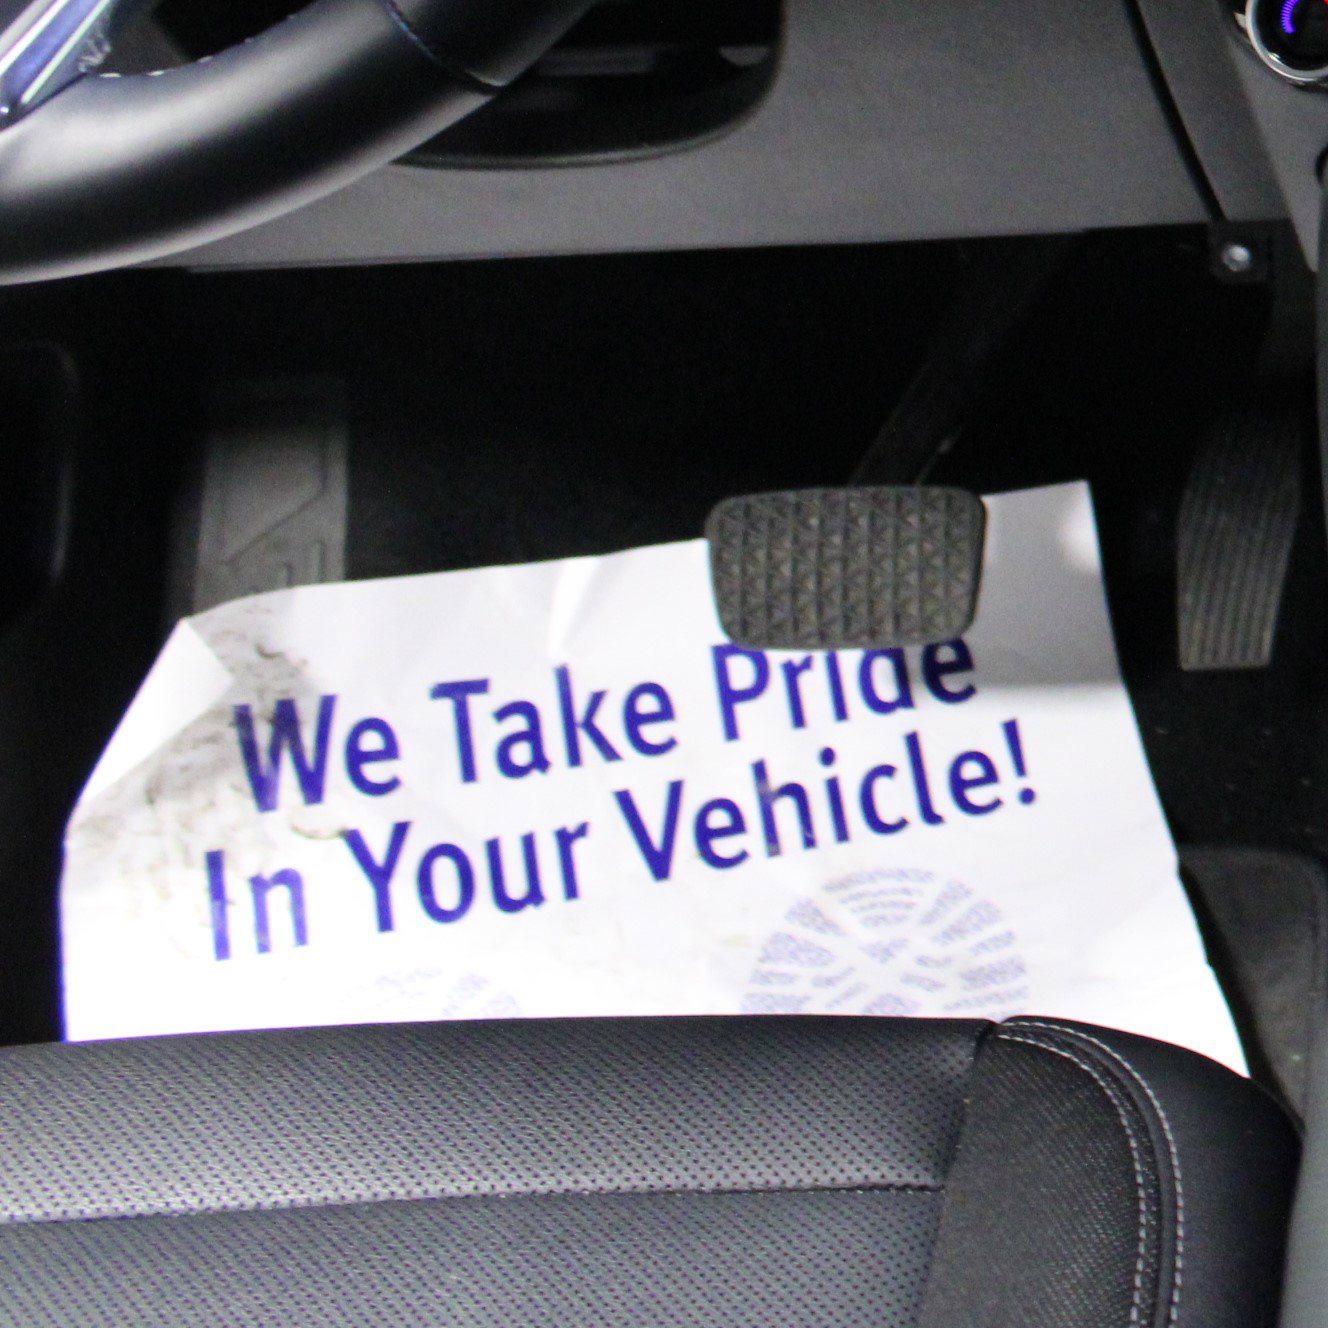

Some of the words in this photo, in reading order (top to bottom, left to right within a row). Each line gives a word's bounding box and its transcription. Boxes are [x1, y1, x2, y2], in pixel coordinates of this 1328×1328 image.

[233, 694, 402, 813] We
[428, 664, 679, 784] Take
[203, 849, 309, 961] In
[342, 820, 590, 934] Your
[613, 718, 1037, 882] Vehicle!
